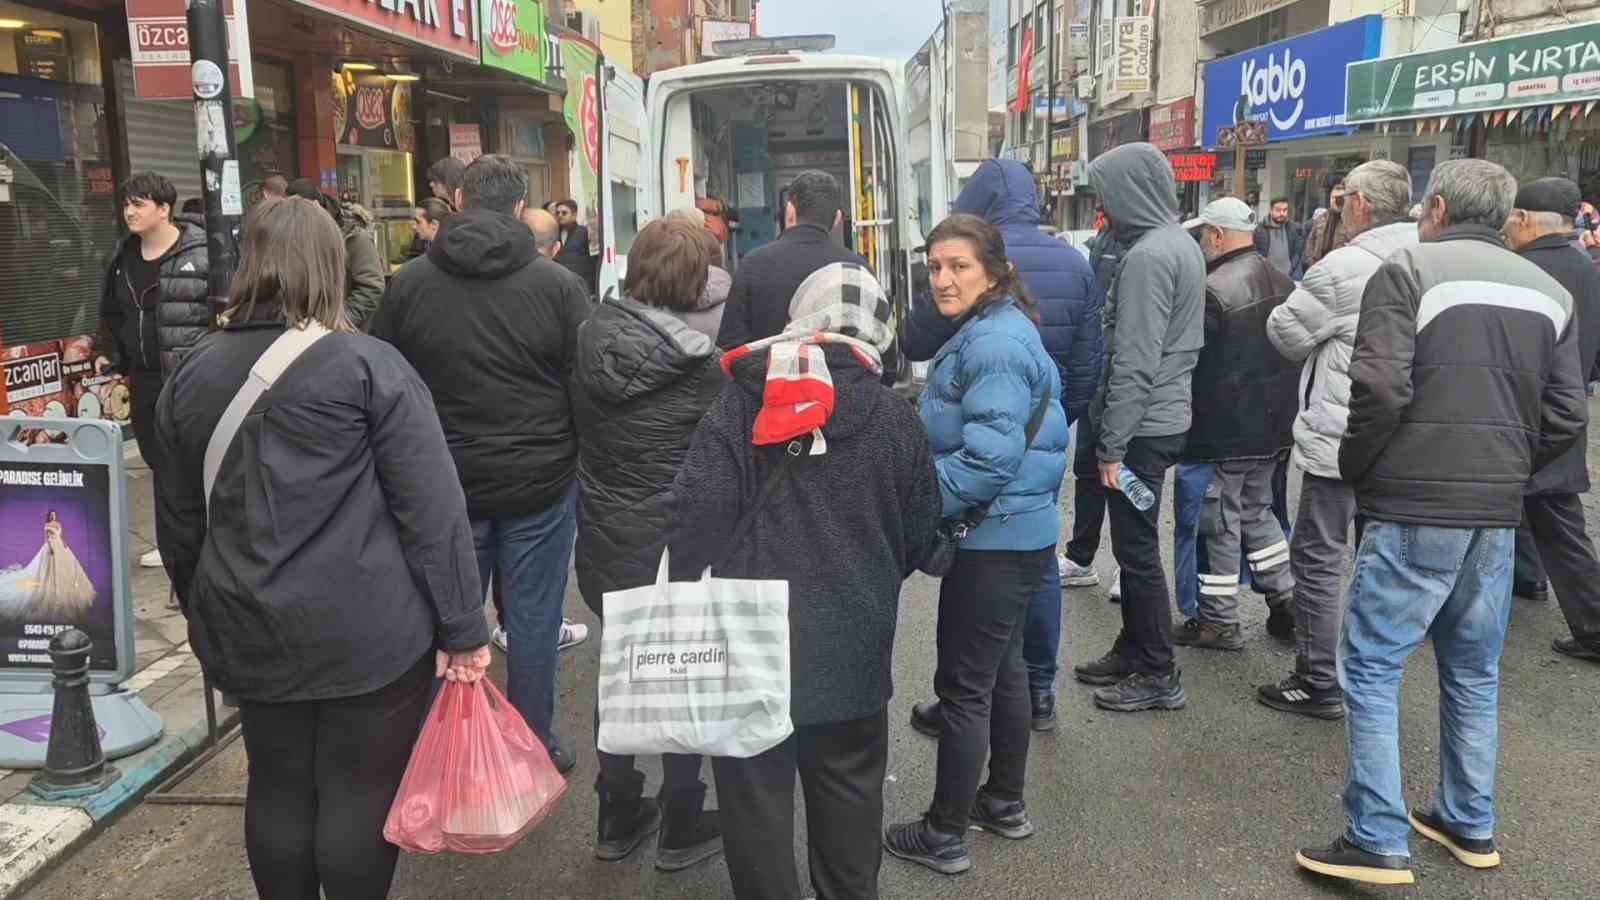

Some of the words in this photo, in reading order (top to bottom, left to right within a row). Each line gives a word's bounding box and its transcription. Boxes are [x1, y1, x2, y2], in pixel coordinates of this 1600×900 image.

[1119, 22, 1138, 77] myra
[1136, 24, 1149, 75] Couture
[1415, 51, 1496, 89] ERSİN
[1241, 48, 1306, 107] Kablo
[636, 650, 676, 670] pierre
[680, 647, 726, 665] cardin
